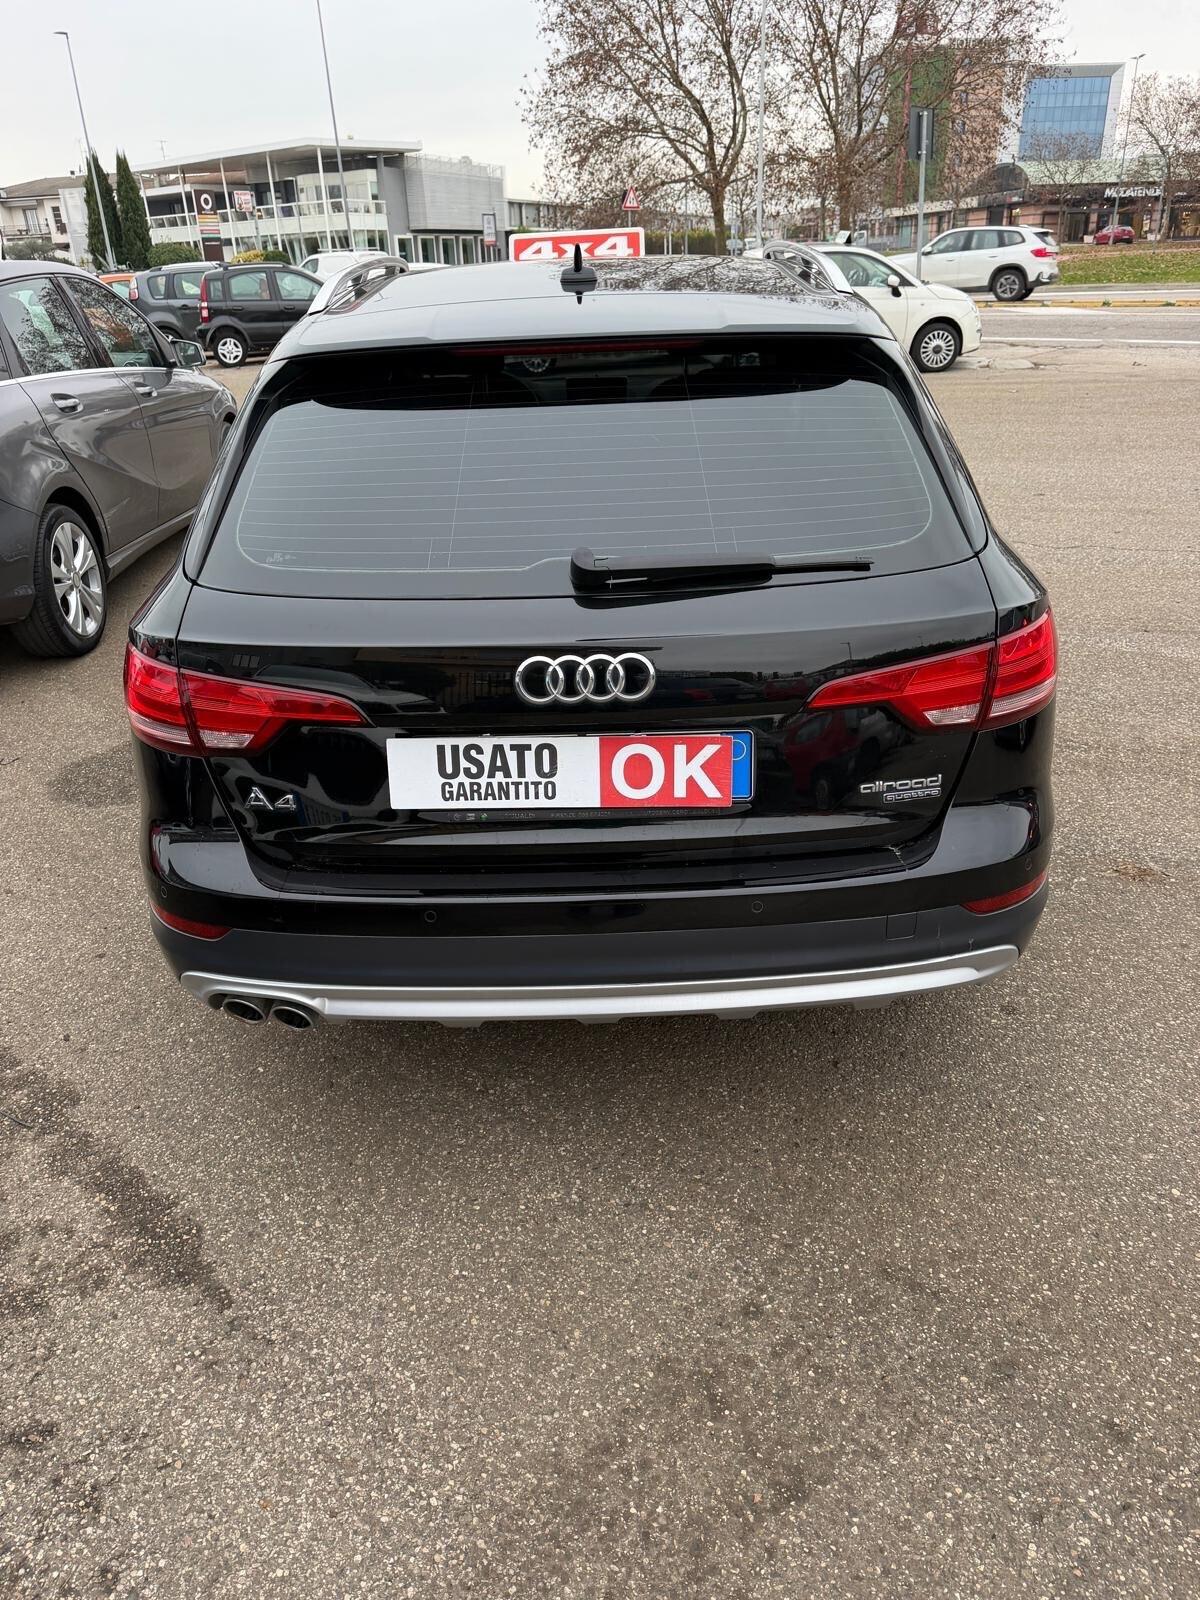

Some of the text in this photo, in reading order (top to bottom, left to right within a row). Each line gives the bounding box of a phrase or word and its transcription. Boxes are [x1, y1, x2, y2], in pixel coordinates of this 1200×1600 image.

[436, 743, 558, 780] USATO
[611, 743, 723, 800] OK
[441, 781, 557, 801] GARANTITO
[860, 774, 942, 794] allroad
[244, 786, 297, 811] A4
